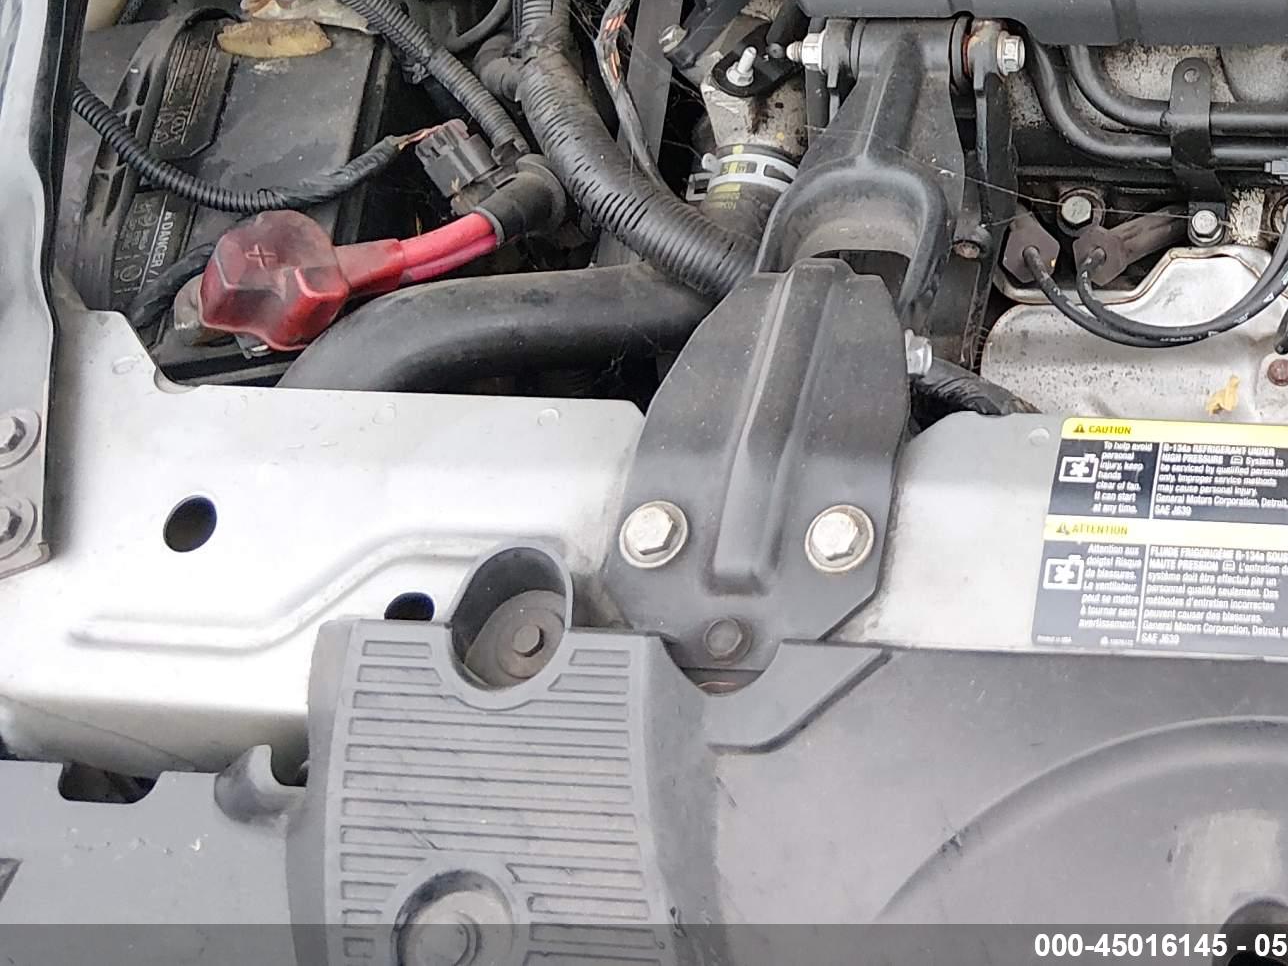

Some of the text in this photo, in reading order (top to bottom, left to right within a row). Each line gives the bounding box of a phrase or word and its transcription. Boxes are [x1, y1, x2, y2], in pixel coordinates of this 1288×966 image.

[1088, 426, 1131, 434] CAUTION
[1156, 494, 1184, 504] General
[1186, 495, 1212, 505] Motors
[1072, 524, 1127, 535] ATTENTION
[1143, 621, 1172, 632] General
[1174, 622, 1201, 633] Motors
